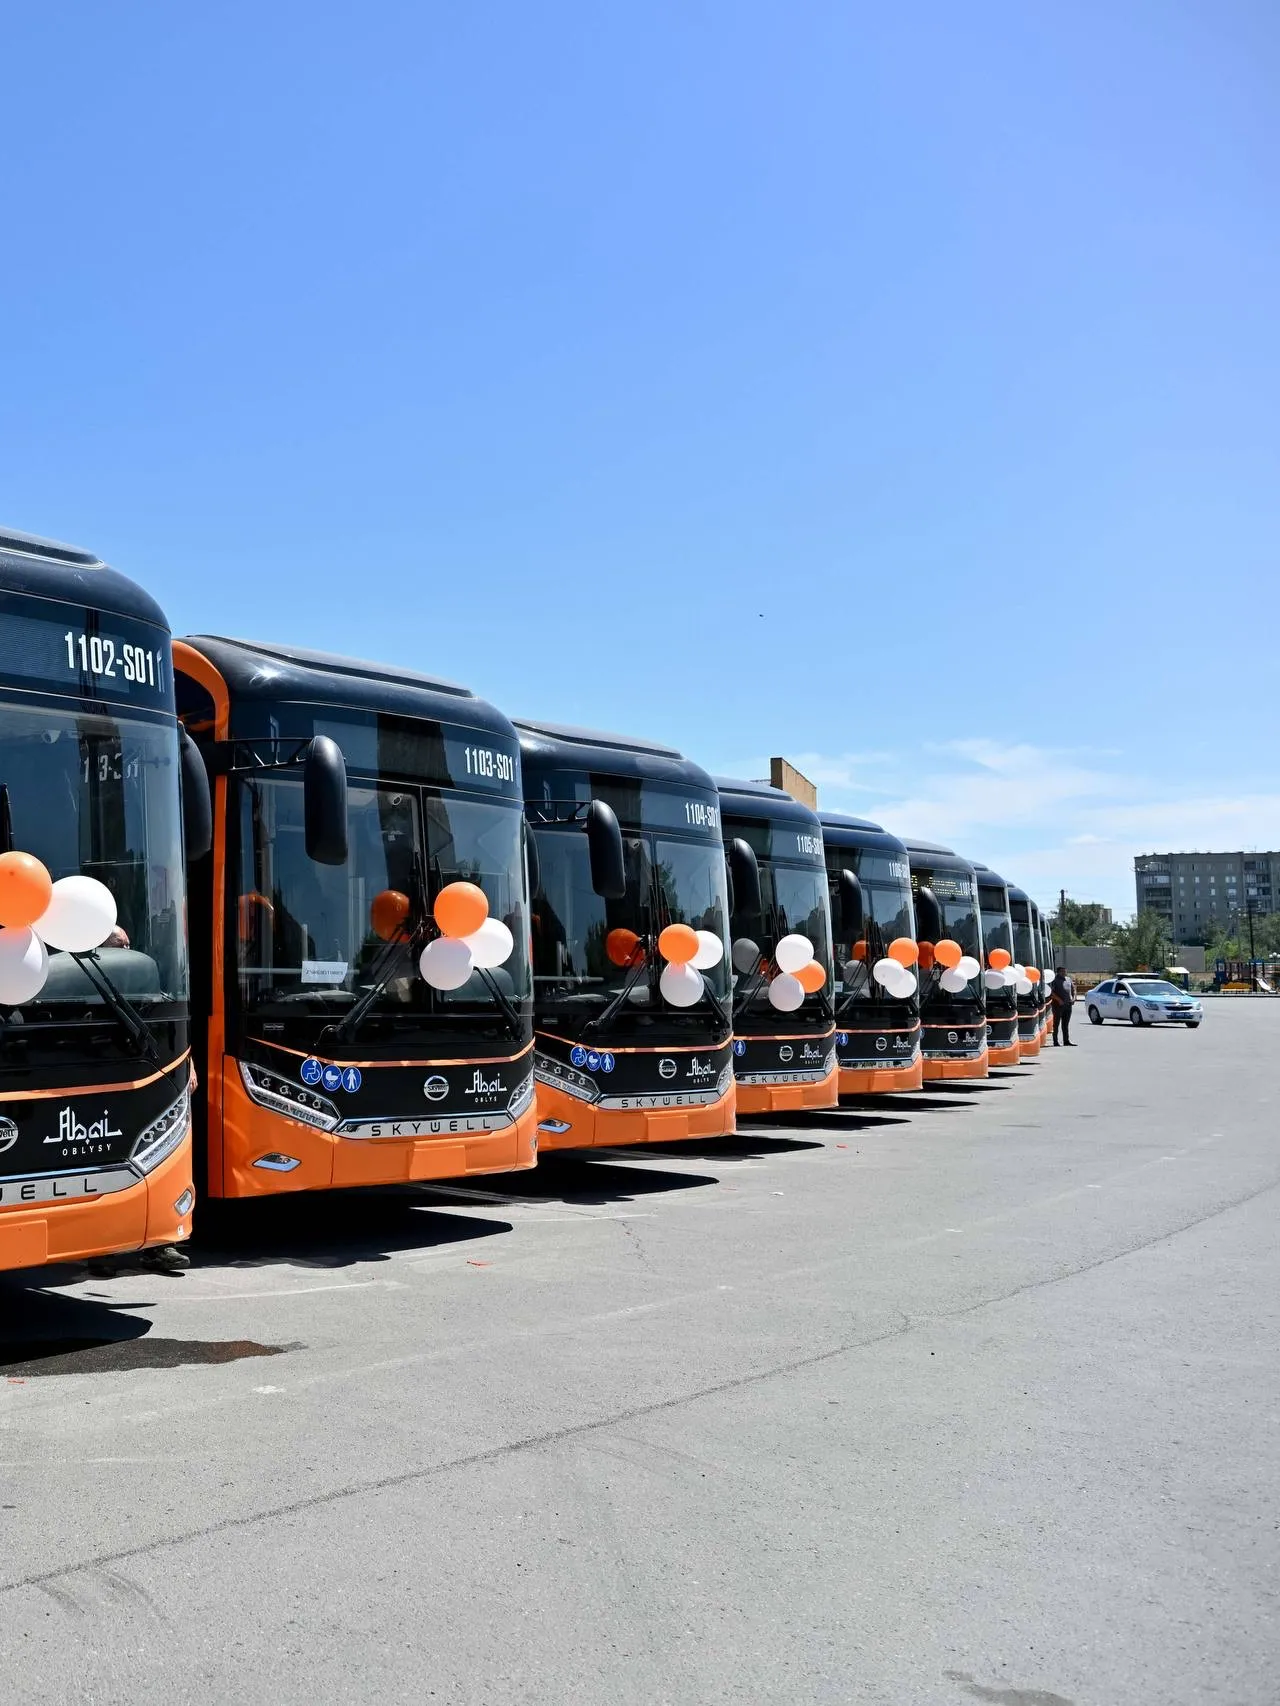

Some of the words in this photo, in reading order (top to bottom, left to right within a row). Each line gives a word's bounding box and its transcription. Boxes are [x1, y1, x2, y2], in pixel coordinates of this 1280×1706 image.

[65, 631, 154, 687] 1102-S01
[465, 747, 514, 783] 1103-S01
[685, 802, 719, 828] 1104-S01
[751, 1073, 816, 1084] SKYWELL
[621, 1095, 706, 1108] SKYWELL
[371, 1118, 491, 1136] SKYWELL
[62, 1143, 112, 1156] OBLYSY
